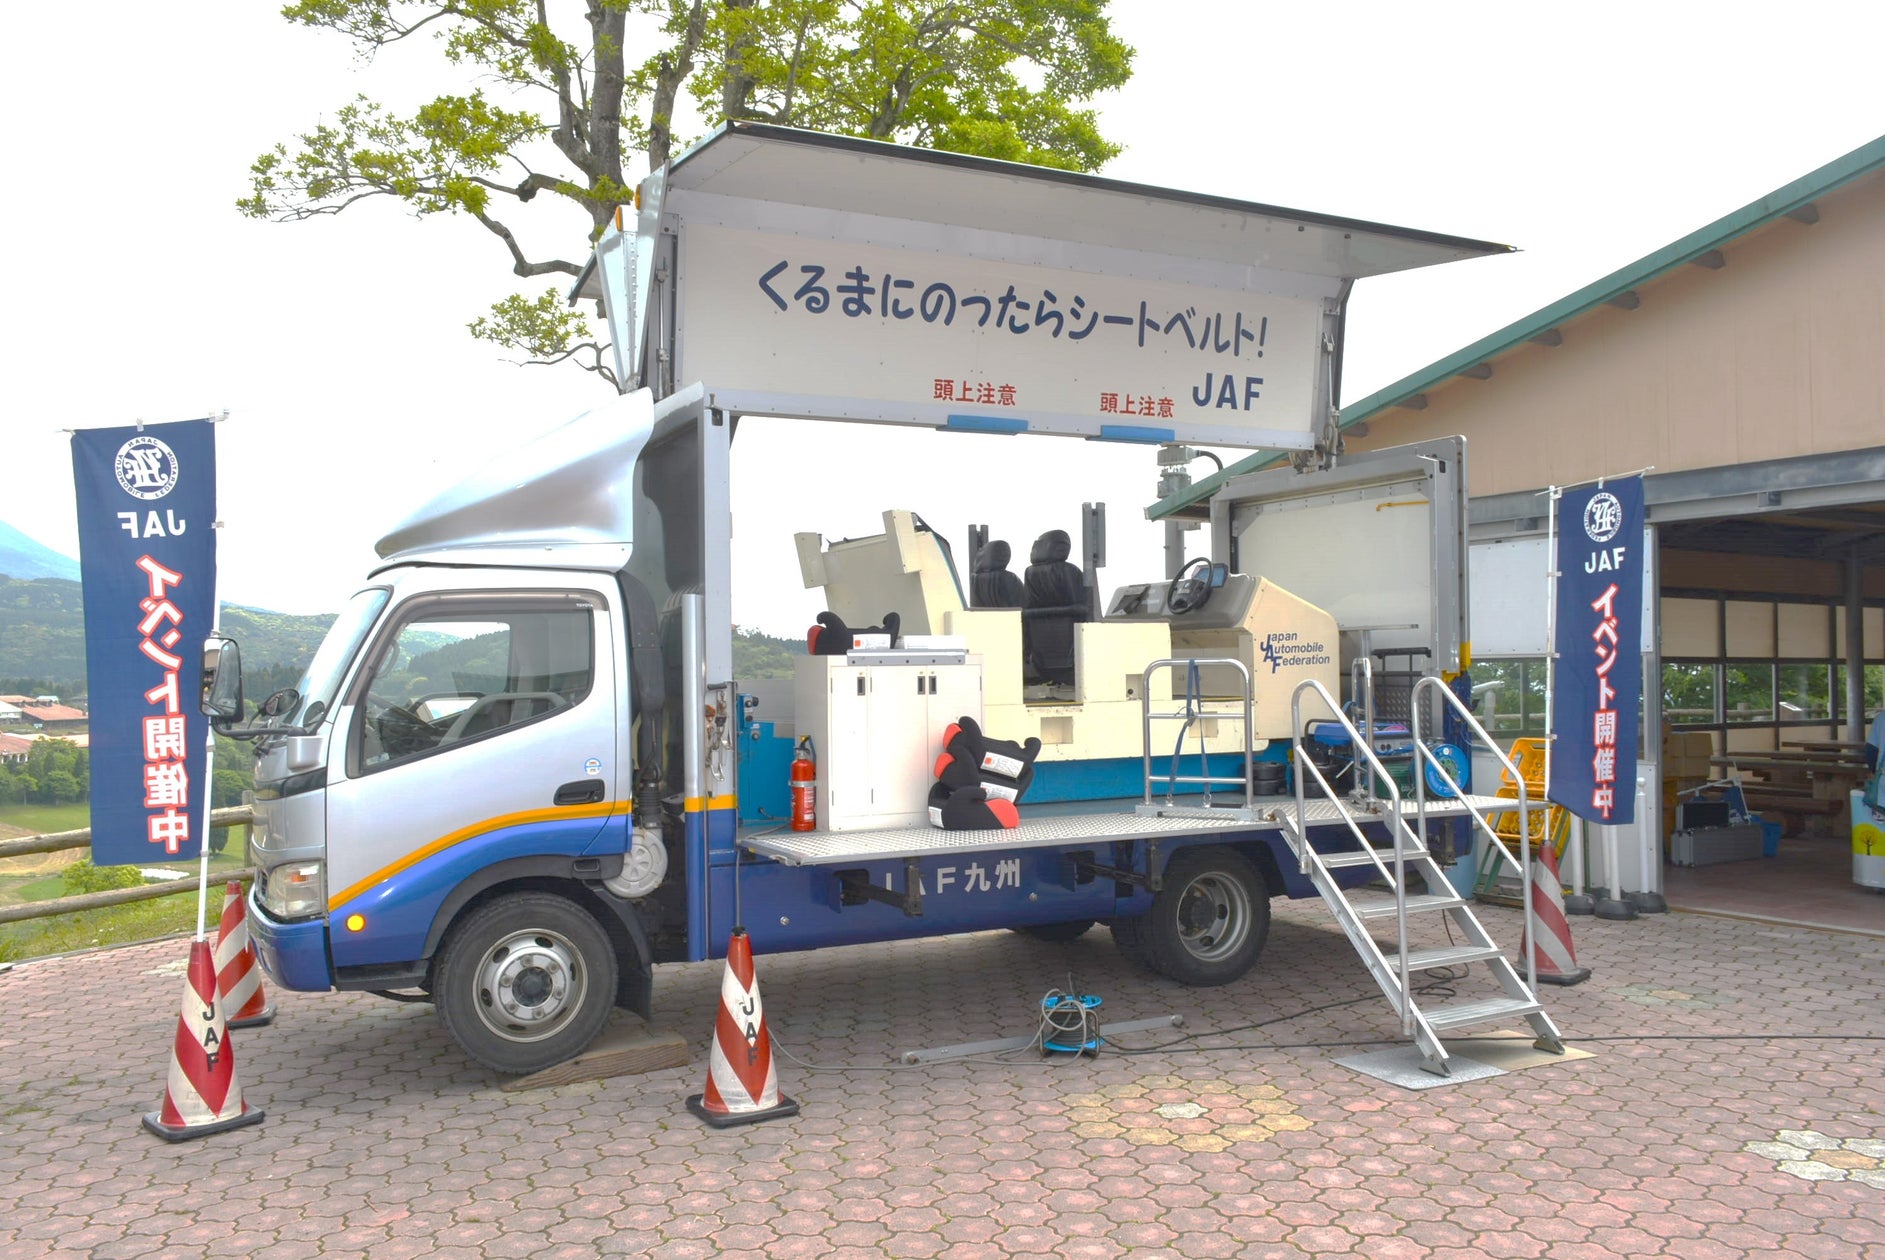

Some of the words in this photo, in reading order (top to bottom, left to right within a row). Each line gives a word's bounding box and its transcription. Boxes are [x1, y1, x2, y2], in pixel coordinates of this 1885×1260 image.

[758, 260, 1267, 358] くるまにのったらシートベルト!
[933, 378, 1017, 407] 頭上注意
[1099, 392, 1175, 418] 頭上注意
[1192, 372, 1264, 411] JAF
[1584, 547, 1626, 574] JAF
[1260, 632, 1298, 651] Japan
[1263, 642, 1324, 662] Automobile
[1272, 655, 1330, 674] Federation
[1591, 583, 1619, 819] イベント開催中
[885, 858, 1021, 896] F九州
[201, 1002, 219, 1072] JAF
[742, 997, 758, 1066] JAF
